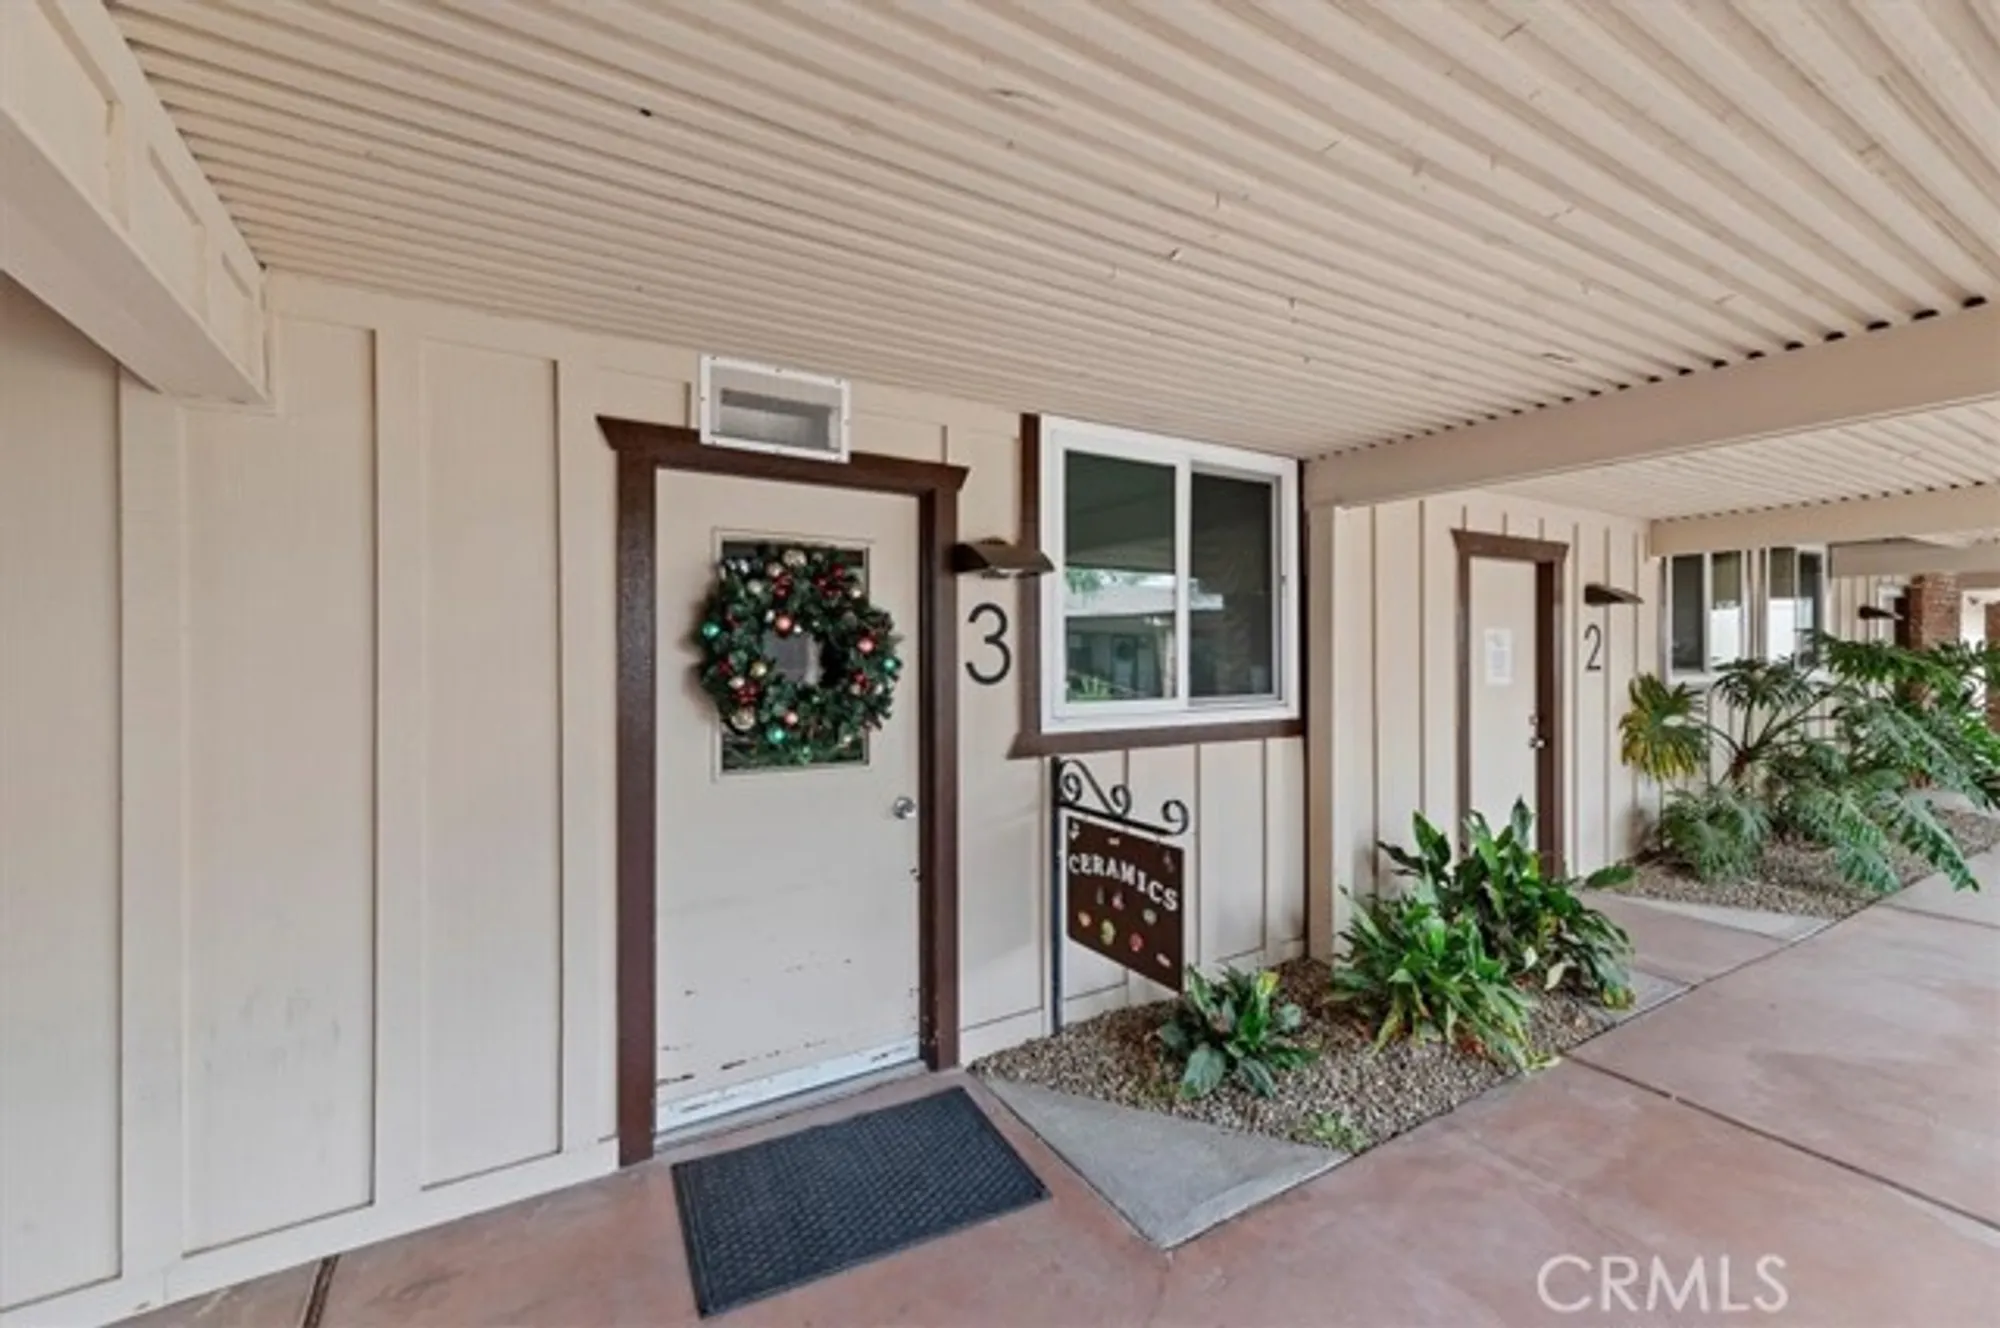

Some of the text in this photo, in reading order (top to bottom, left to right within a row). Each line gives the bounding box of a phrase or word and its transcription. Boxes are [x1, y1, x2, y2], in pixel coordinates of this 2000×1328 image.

[965, 602, 1011, 685] 3
[1584, 623, 1602, 671] 2
[1068, 853, 1179, 912] CERAMICS
